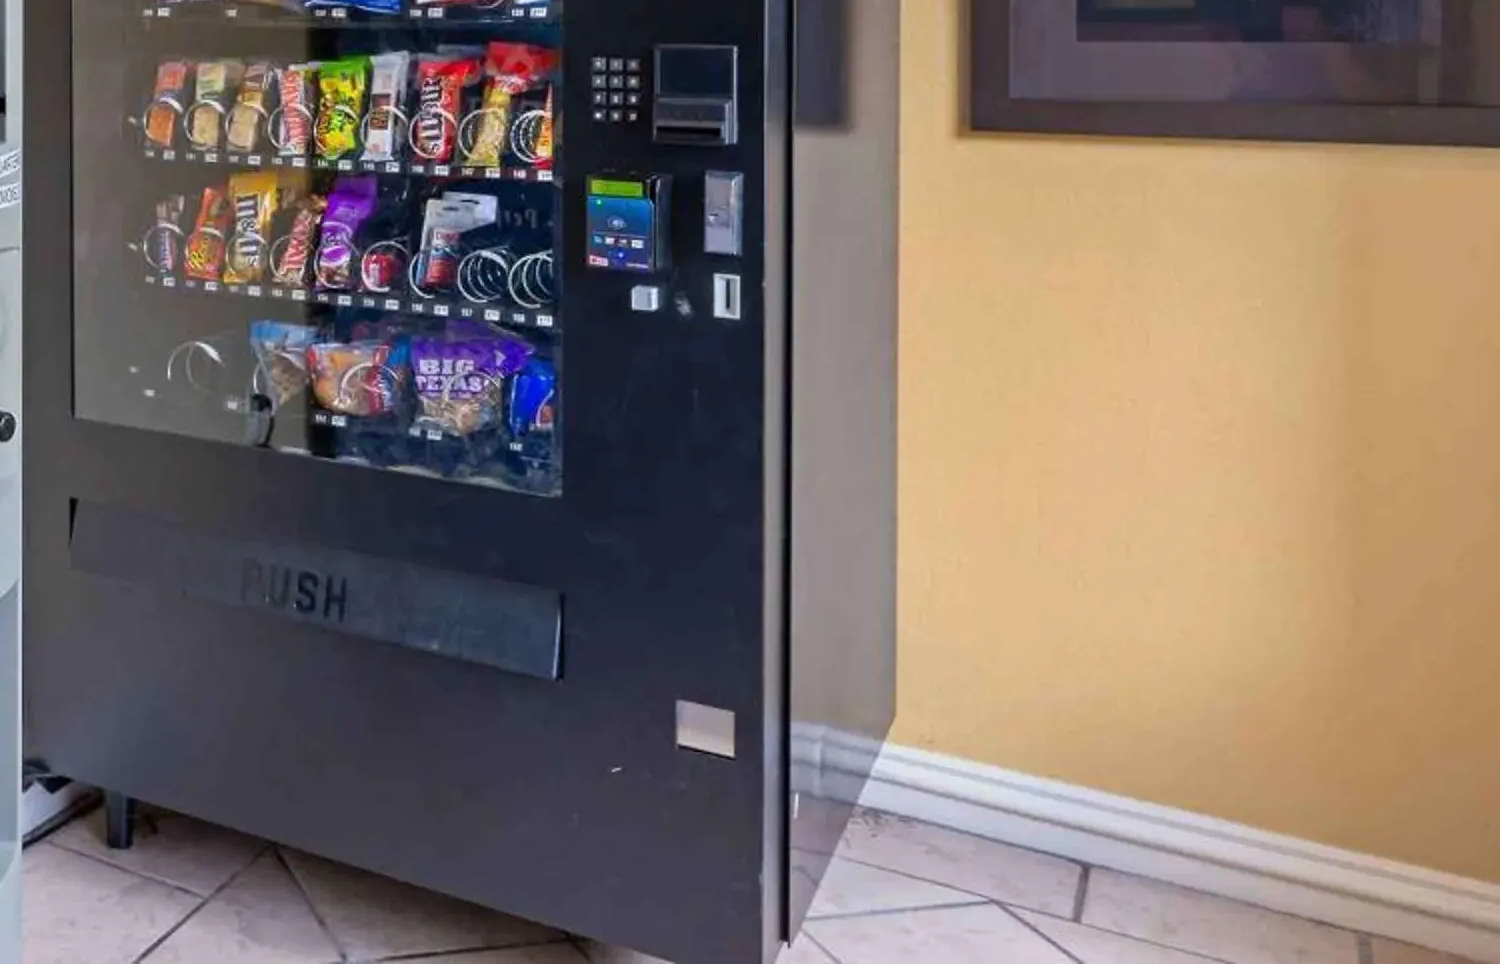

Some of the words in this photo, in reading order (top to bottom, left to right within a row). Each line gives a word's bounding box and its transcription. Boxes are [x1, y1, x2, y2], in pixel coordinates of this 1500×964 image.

[419, 359, 476, 375] BIG
[415, 375, 483, 392] TEXAS
[241, 557, 348, 623] PUSH
